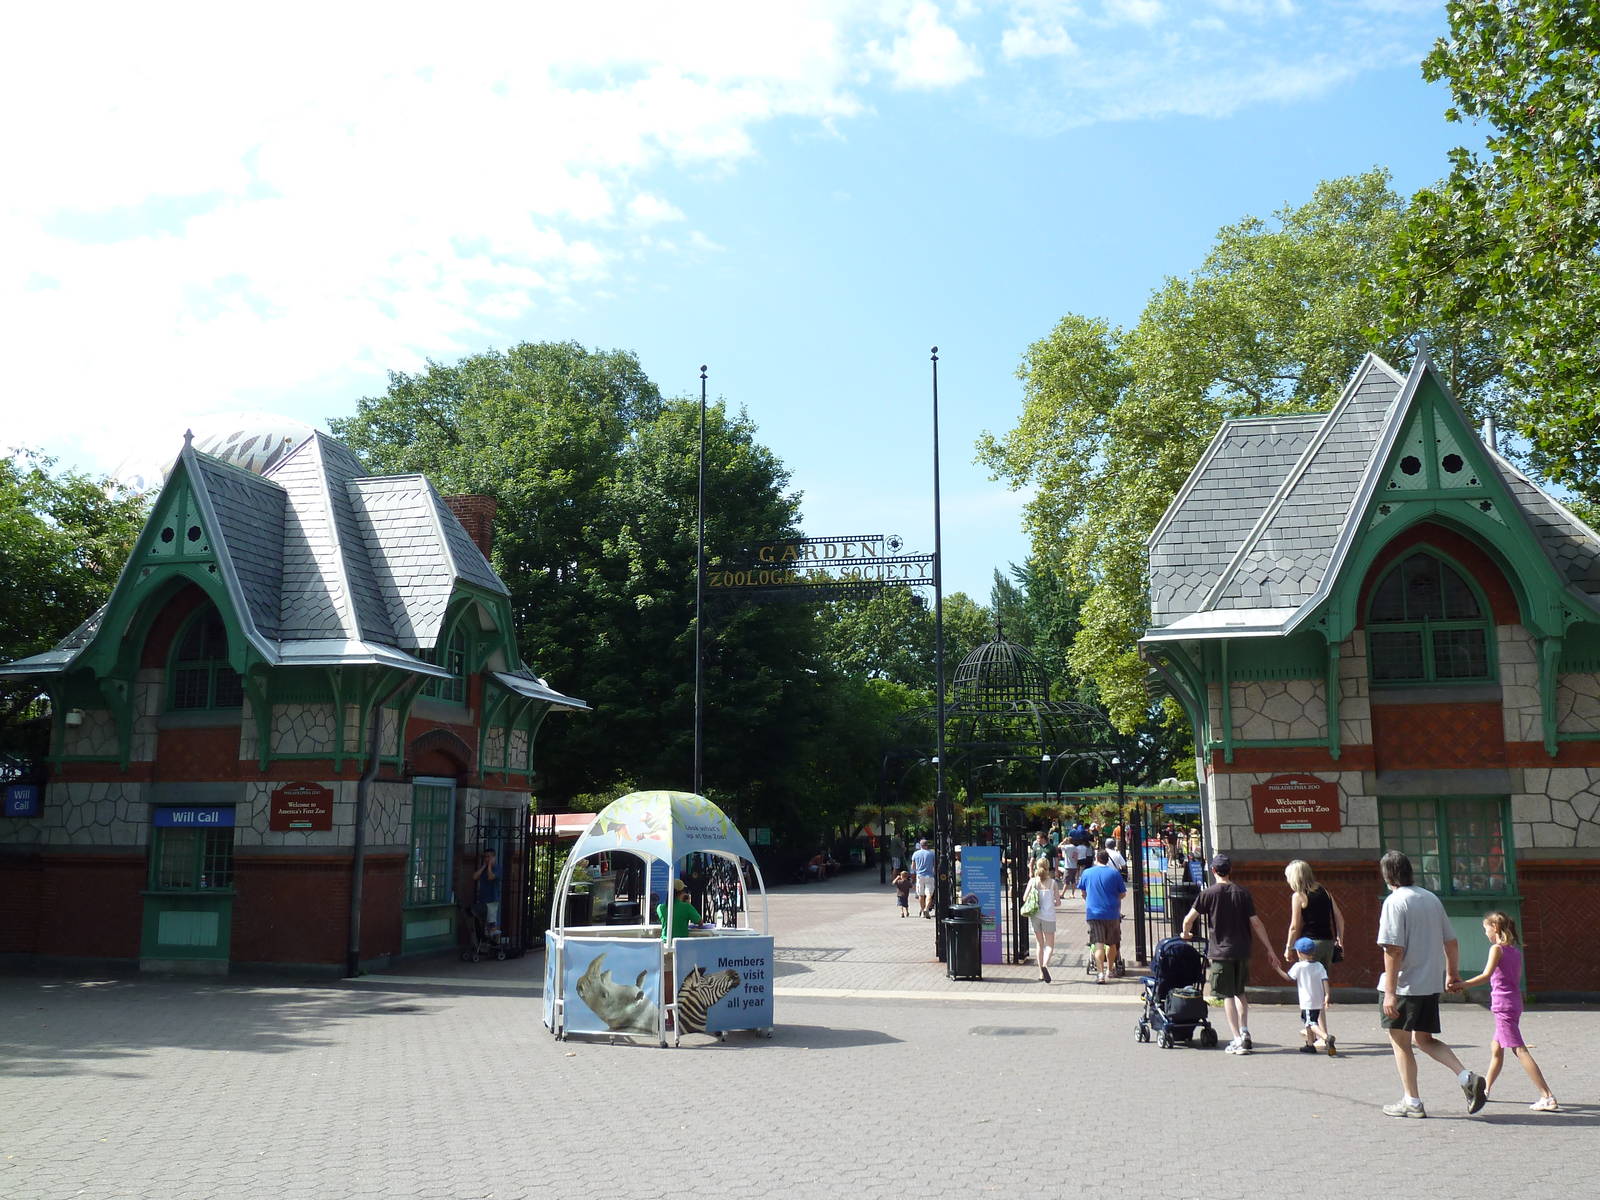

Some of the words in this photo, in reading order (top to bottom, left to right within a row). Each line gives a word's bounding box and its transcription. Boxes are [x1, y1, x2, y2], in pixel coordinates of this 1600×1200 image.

[759, 541, 878, 562] GARDEN
[840, 562, 930, 582] SOCIETY
[14, 790, 30, 799] Will
[14, 800, 30, 810] Call
[172, 811, 195, 823] Will
[197, 811, 219, 823] Call
[718, 956, 765, 968] Members
[743, 969, 765, 980] visit
[744, 982, 765, 994] free
[728, 997, 740, 1008] all
[743, 998, 764, 1009] year
